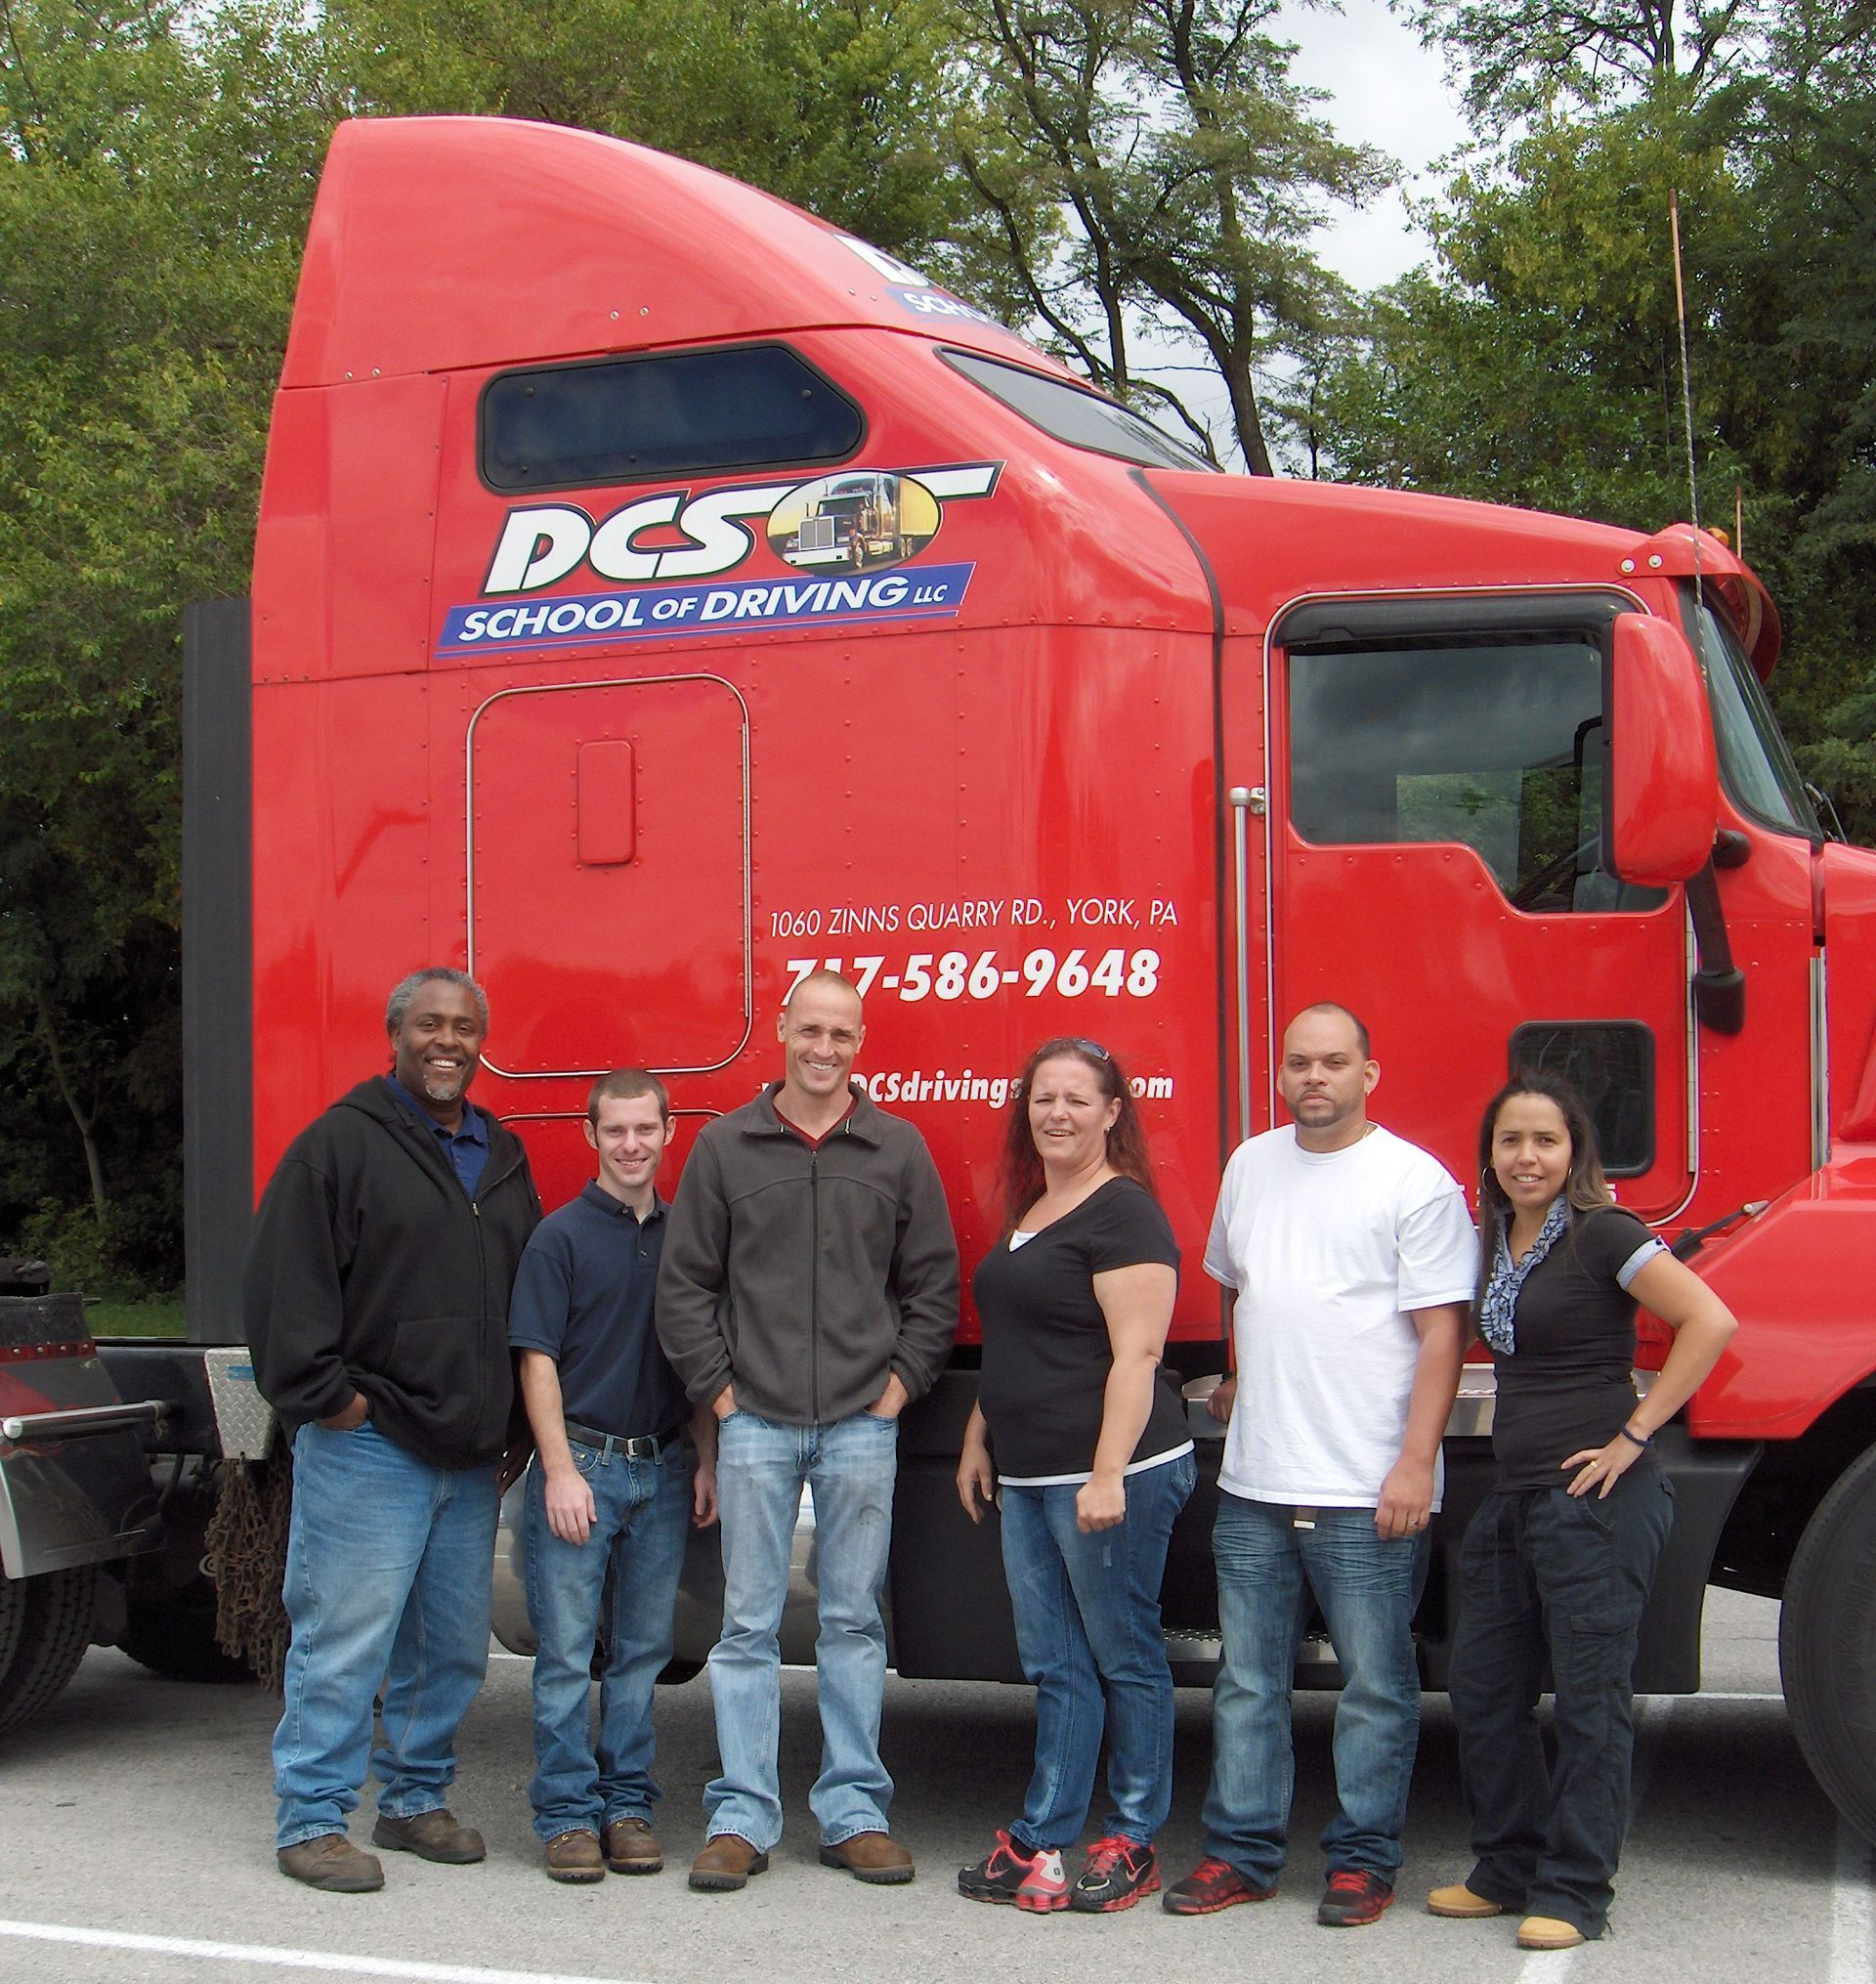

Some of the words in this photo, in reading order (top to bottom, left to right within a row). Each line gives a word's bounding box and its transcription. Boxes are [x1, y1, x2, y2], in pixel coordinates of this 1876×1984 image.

[902, 292, 990, 323] SCHO
[481, 477, 803, 594] DCS
[457, 598, 644, 641] SCHOOL
[657, 596, 697, 621] OF
[699, 576, 909, 622] DRIVING
[914, 583, 949, 605] LLC
[770, 909, 822, 937] 1060
[827, 905, 900, 935] ZINNS
[907, 899, 1004, 931] QUARRY
[1010, 898, 1056, 929] RD.,
[1066, 898, 1140, 930] YORK,
[1149, 899, 1178, 926] PA
